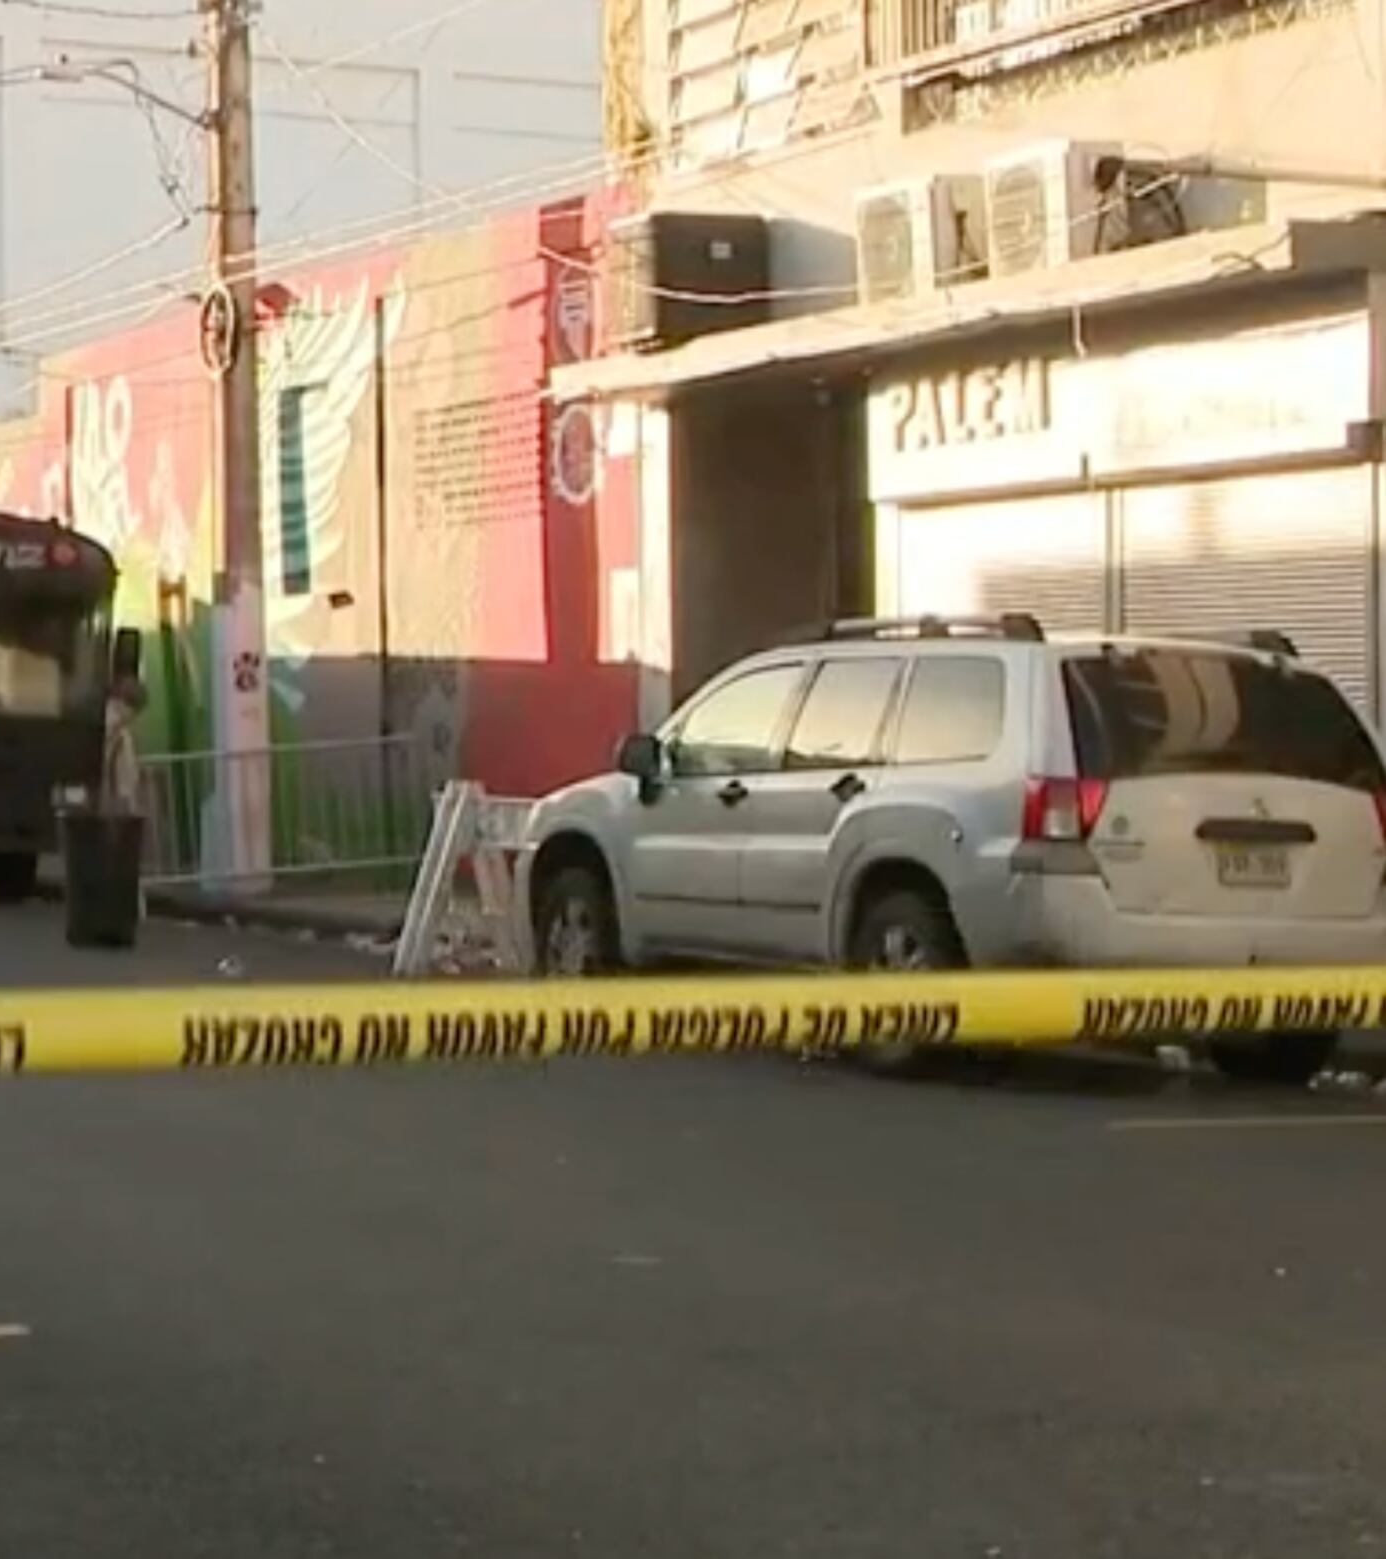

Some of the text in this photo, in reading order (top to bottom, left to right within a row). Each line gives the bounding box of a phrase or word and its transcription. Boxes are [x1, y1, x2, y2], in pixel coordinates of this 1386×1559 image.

[1080, 997, 1208, 1038] CRUZAR
[1217, 995, 1264, 1029] NO
[180, 1002, 959, 1068] LINEA DE POLICIA POR FAVOR NO CRUZAR
